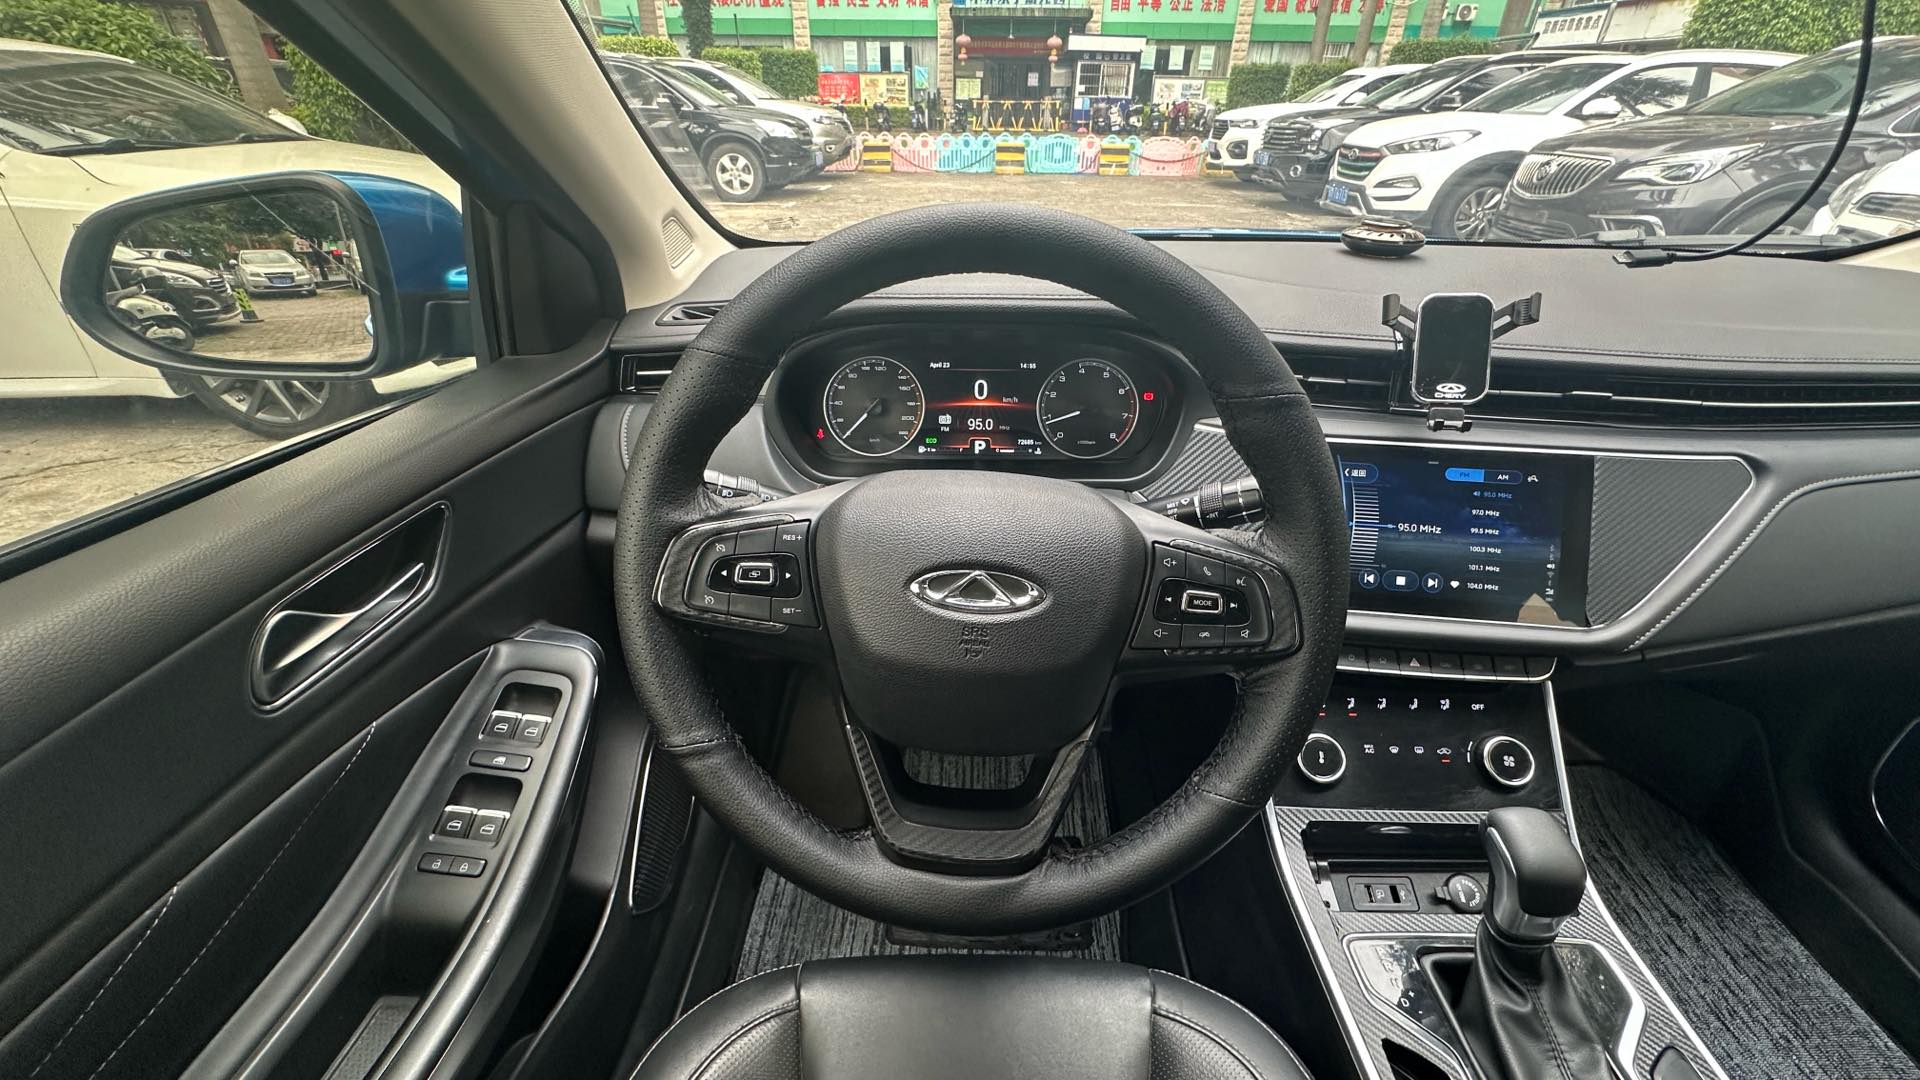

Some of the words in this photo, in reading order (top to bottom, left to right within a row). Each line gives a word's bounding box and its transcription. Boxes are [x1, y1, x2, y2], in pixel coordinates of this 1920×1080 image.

[974, 379, 988, 400] 0
[967, 418, 993, 430] 95.0
[974, 440, 986, 454] P
[1398, 523, 1417, 533] 95.0
[1420, 524, 1442, 534] MHz
[1484, 583, 1499, 591] MHz
[1193, 599, 1212, 607] MODE
[961, 626, 989, 638] SRS
[1471, 703, 1485, 711] OFF
[1400, 998, 1410, 1008] D
